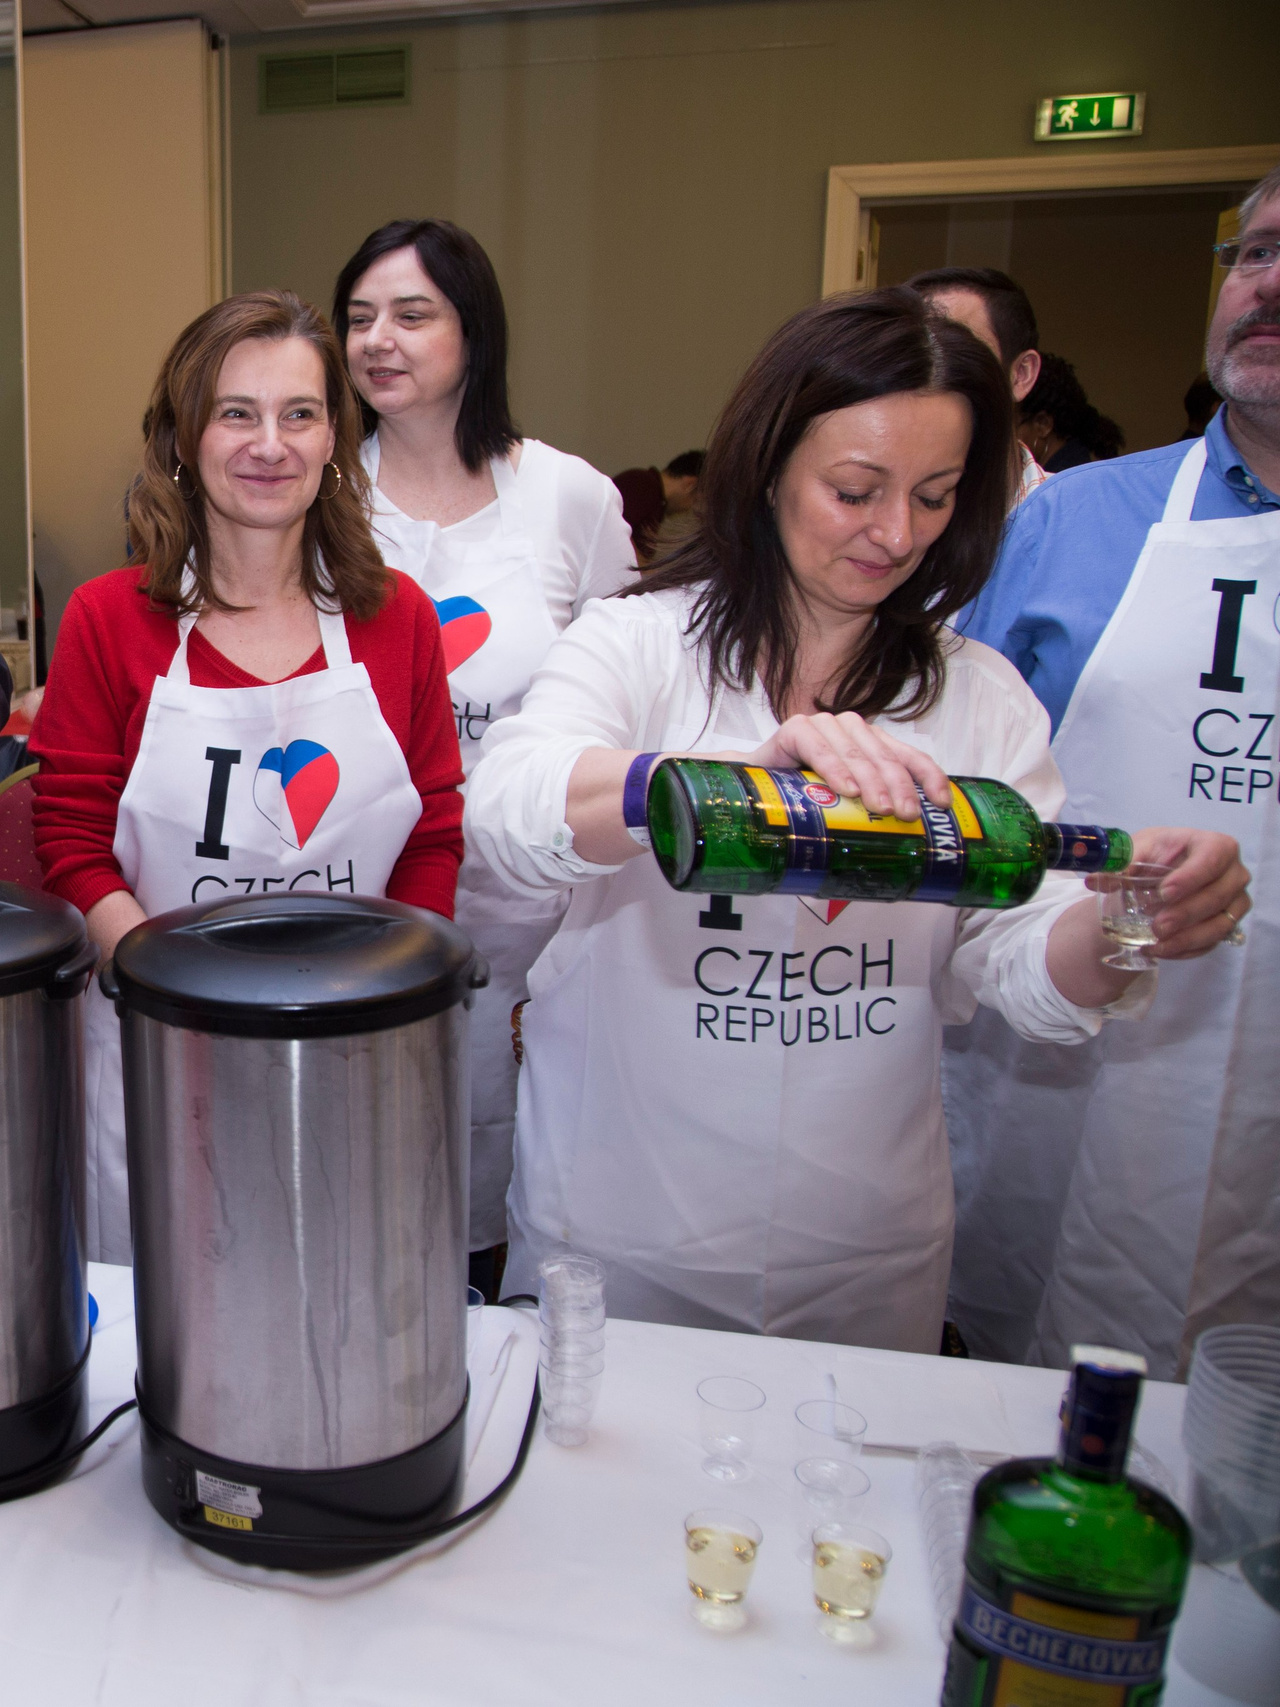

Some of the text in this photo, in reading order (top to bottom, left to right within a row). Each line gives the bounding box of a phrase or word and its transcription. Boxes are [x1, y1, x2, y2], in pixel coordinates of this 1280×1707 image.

[1199, 578, 1258, 693] I
[1192, 708, 1280, 761] CZ
[195, 746, 242, 861] I
[1188, 762, 1280, 805] REP
[694, 938, 894, 1002] CZECH
[696, 996, 897, 1047] REPUBLIC
[212, 1510, 246, 1529] 37161
[972, 1604, 1161, 1675] BECHEROVKA
